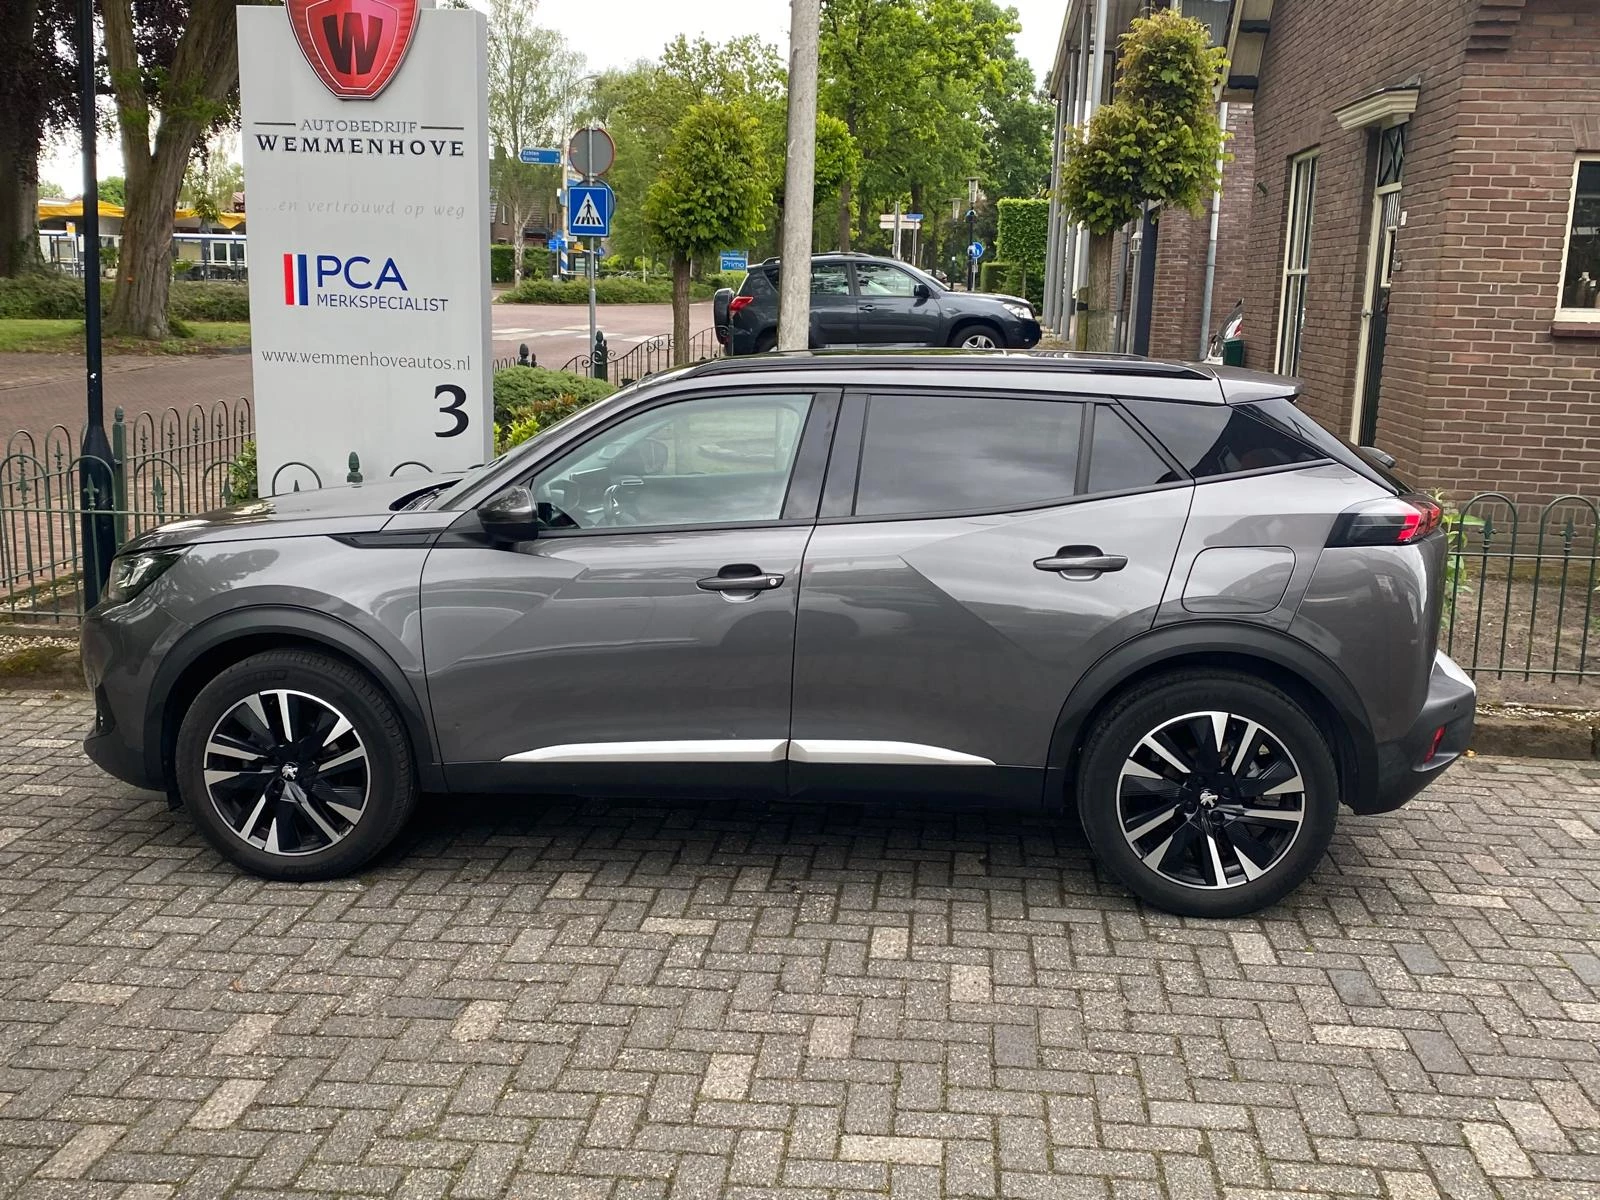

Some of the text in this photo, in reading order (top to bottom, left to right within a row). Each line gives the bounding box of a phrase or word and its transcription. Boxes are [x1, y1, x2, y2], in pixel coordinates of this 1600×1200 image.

[322, 12, 384, 76] W
[300, 119, 418, 133] AUTOBEDRIJF
[254, 134, 465, 157] WEMMENHOVE
[307, 200, 396, 216] vertrouwd
[404, 203, 425, 218] op
[433, 204, 466, 219] weg
[316, 255, 409, 291] PCA
[723, 260, 745, 268] Primo
[316, 294, 449, 312] MERKSPECIALIST
[261, 350, 471, 371] www.wemmenhoveautos.nl
[434, 384, 470, 438] 3
